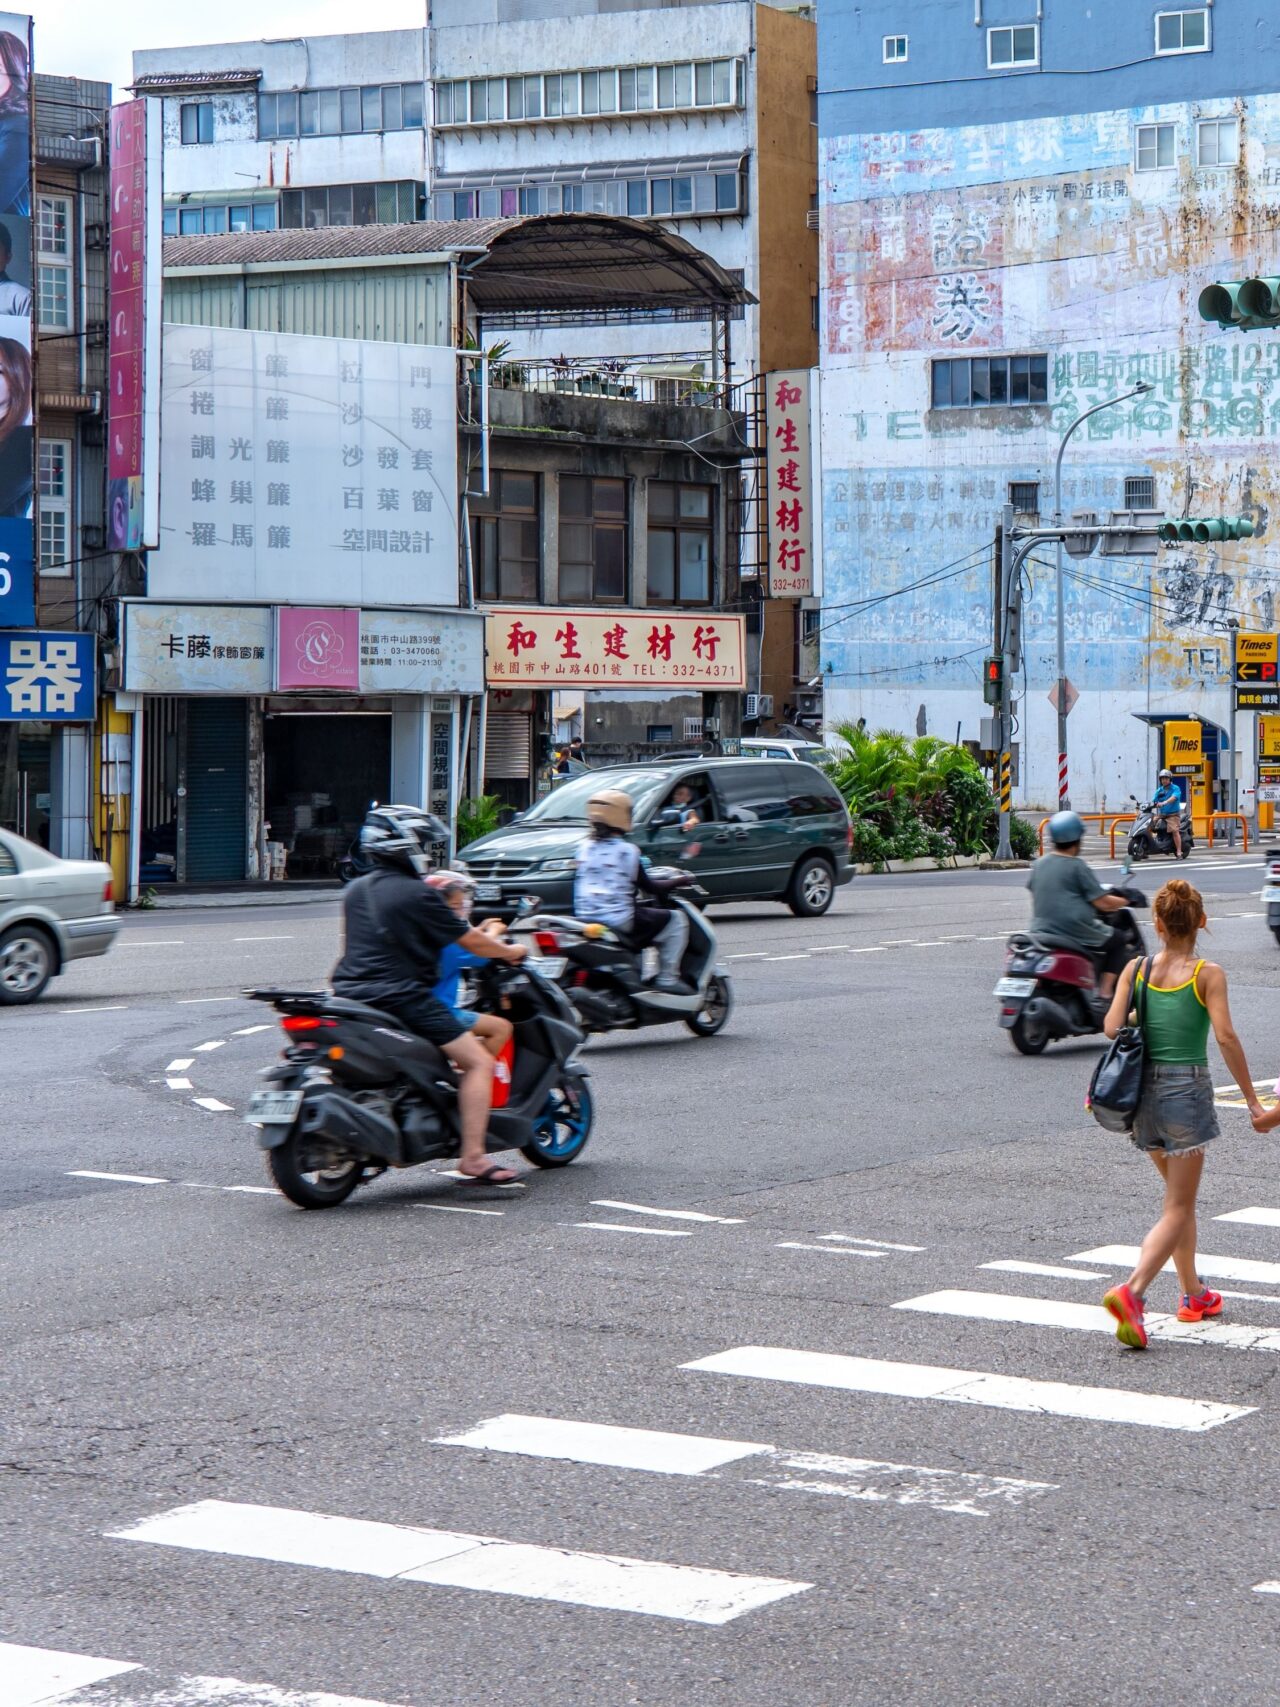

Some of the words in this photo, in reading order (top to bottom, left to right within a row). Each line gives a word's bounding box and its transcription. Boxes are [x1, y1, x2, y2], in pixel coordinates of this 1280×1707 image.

[191, 435, 290, 463] 調光簾
[342, 443, 433, 472] 沙發套
[774, 379, 806, 573] 和生建材行
[191, 478, 291, 507] 蜂巢簾
[342, 486, 434, 513] 百葉窗
[192, 522, 290, 549] 羅馬簾
[342, 528, 434, 553] 空間設計
[773, 579, 809, 591] 332-4371
[361, 635, 441, 645] 桃園市中山路399號
[506, 620, 722, 662] 和生建材行
[1240, 639, 1273, 650] Times
[4, 640, 83, 713] 器
[493, 661, 622, 677] 桃園市中山路401號
[672, 664, 735, 678] 332-4371
[1238, 694, 1279, 705] 無現金繳費
[1172, 735, 1199, 751] Times
[1273, 741, 1280, 751] 35
